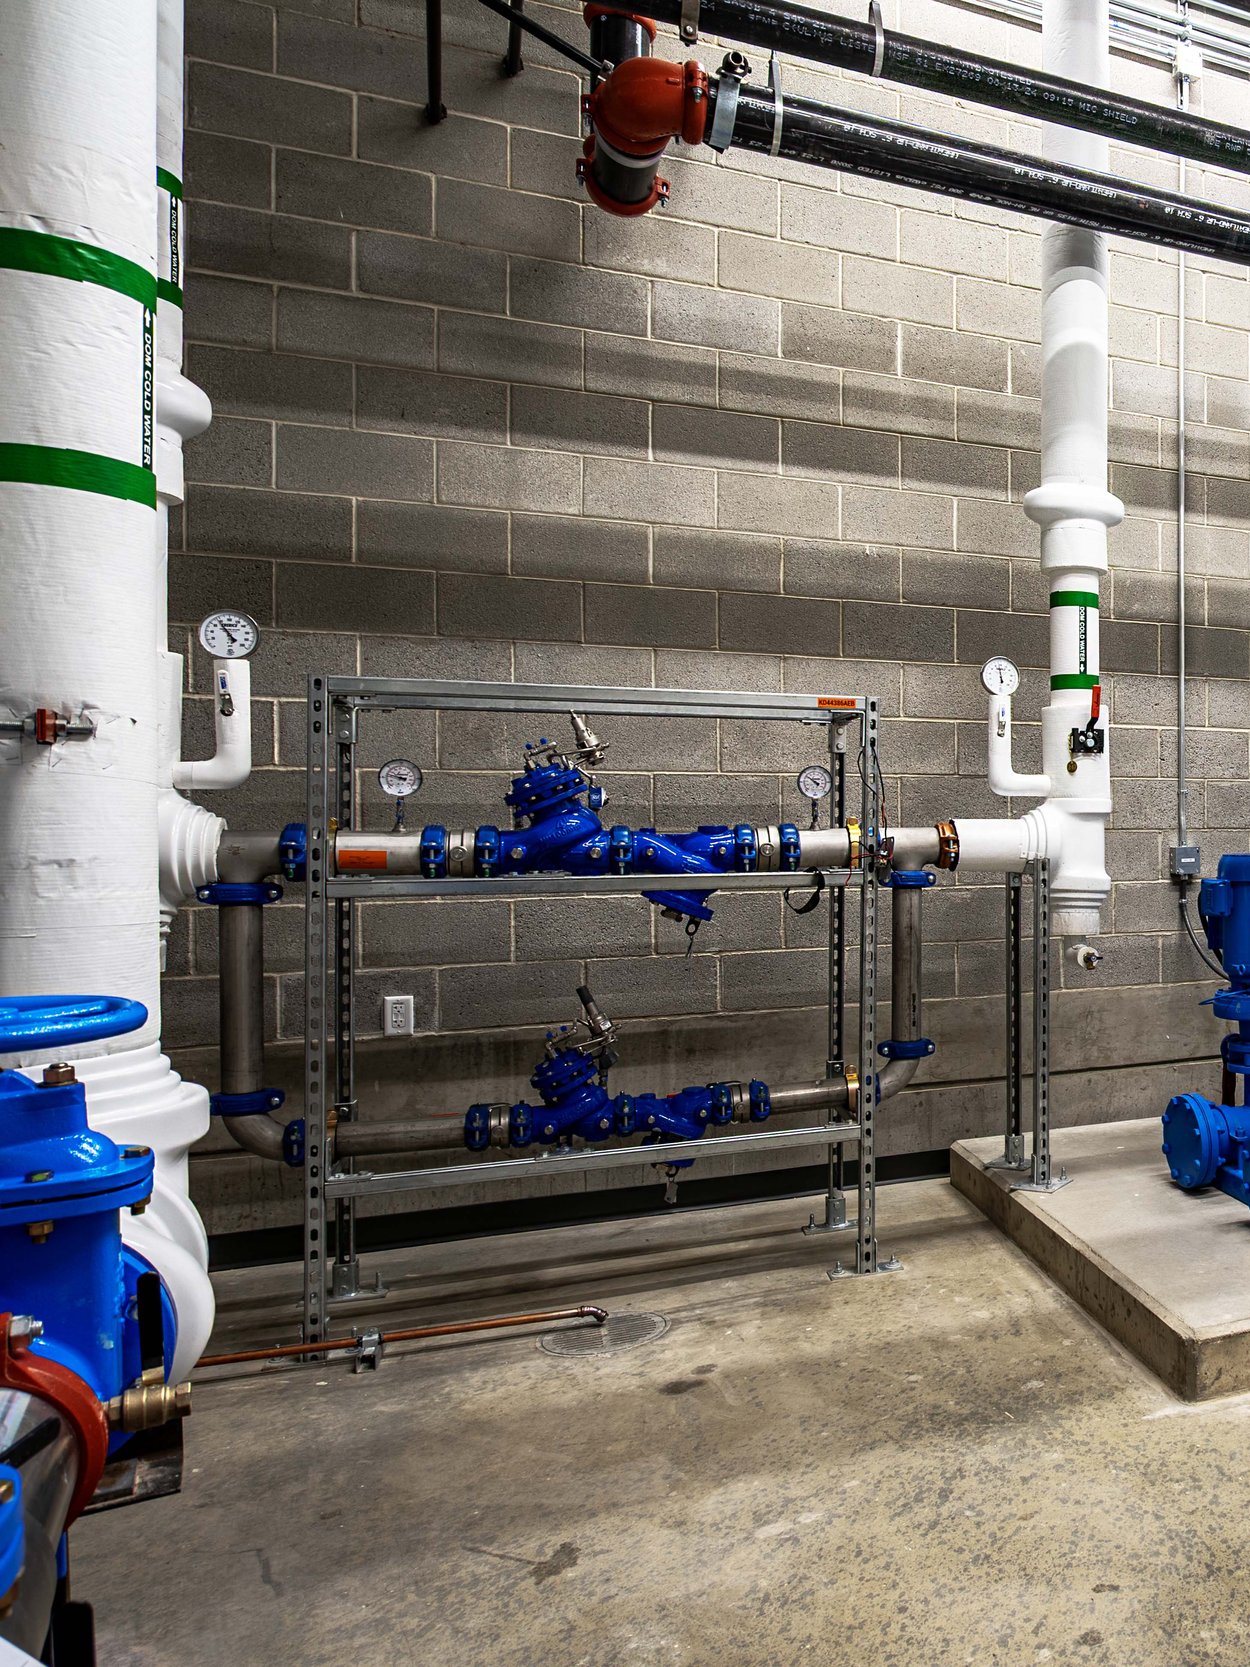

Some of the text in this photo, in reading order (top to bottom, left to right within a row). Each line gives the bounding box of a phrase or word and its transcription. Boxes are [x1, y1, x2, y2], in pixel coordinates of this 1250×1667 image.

[839, 36, 875, 53] LISTE
[1102, 107, 1138, 124] SHIELD
[144, 332, 152, 466] DOM COLD WATER
